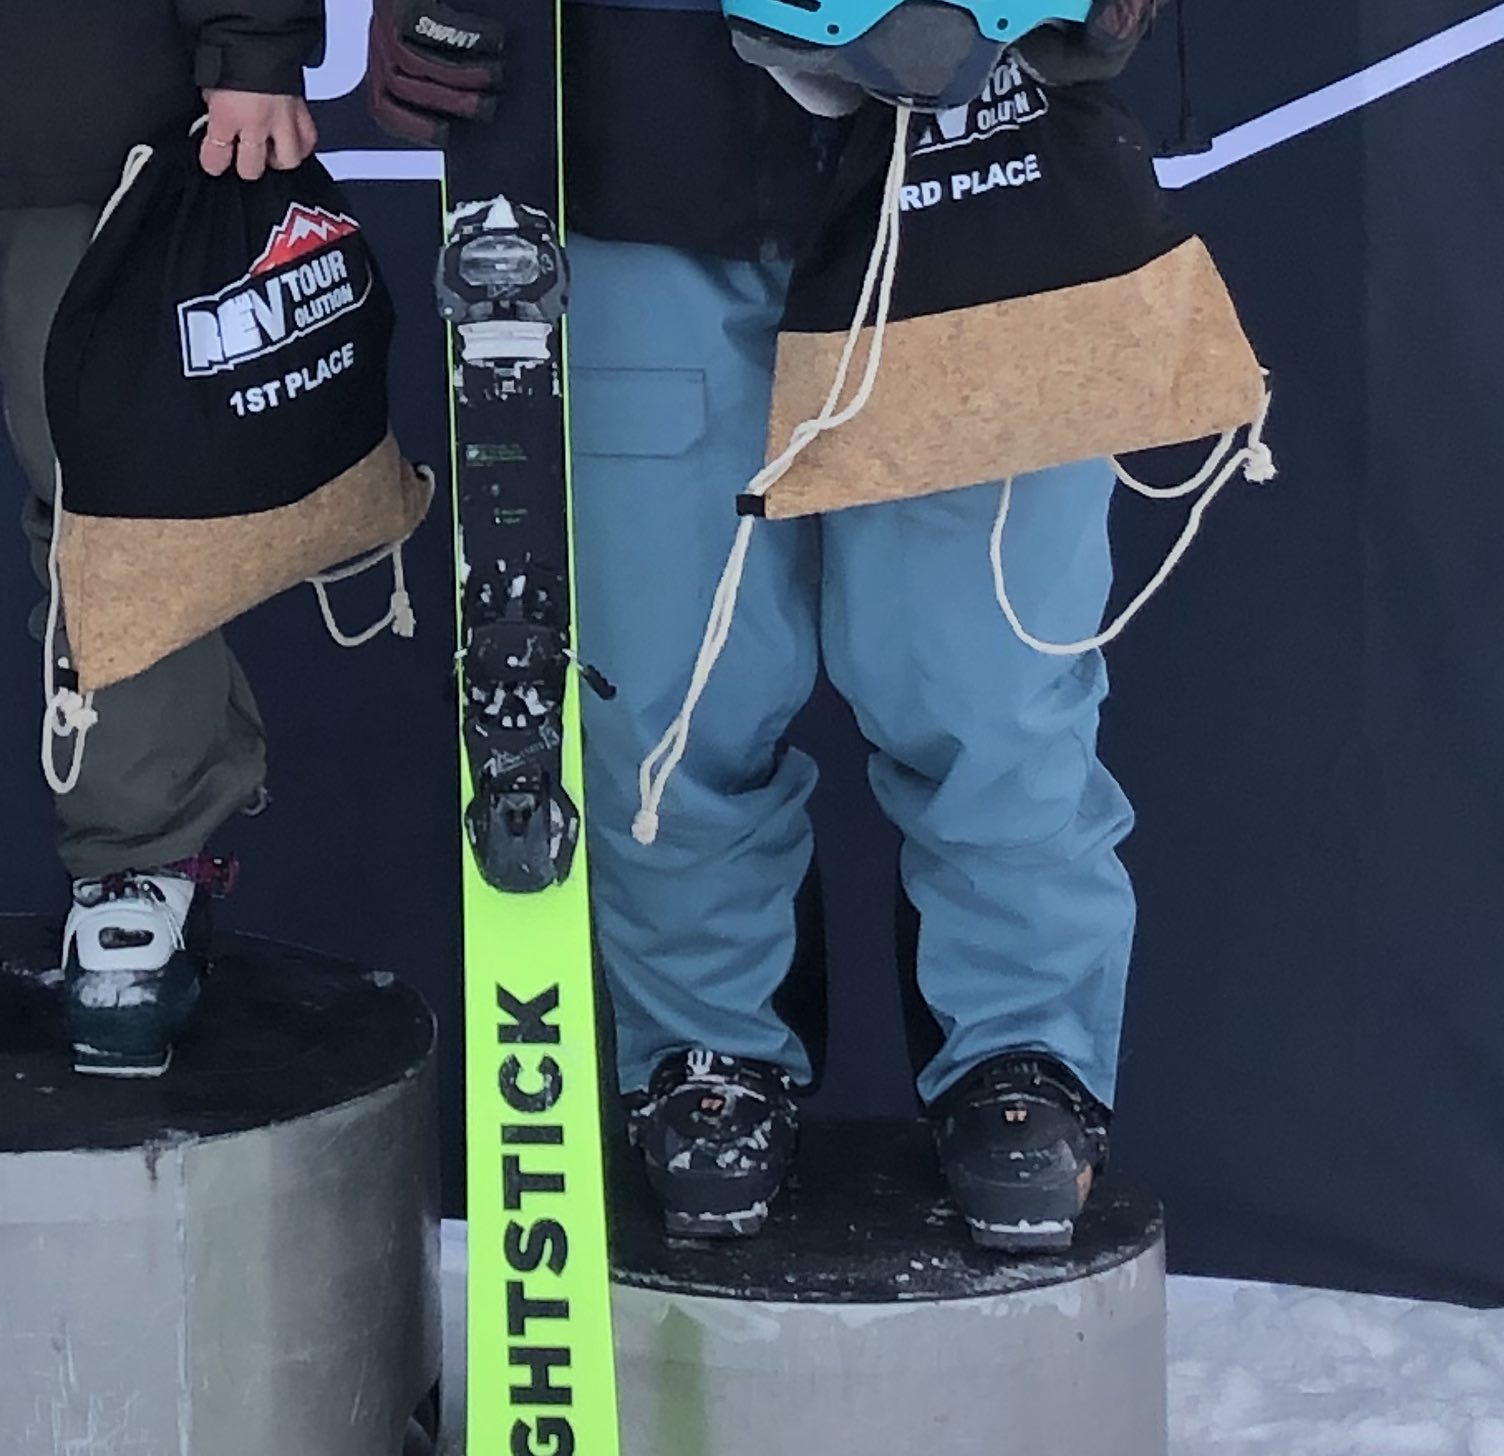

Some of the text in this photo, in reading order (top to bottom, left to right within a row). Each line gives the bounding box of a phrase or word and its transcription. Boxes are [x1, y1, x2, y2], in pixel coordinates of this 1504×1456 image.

[899, 153, 1042, 212] RD PLACE
[186, 249, 348, 369] REV TOUR
[294, 283, 355, 329] OLUTION
[229, 342, 355, 417] 1ST PLACE
[494, 981, 578, 1456] GHTSTICK
